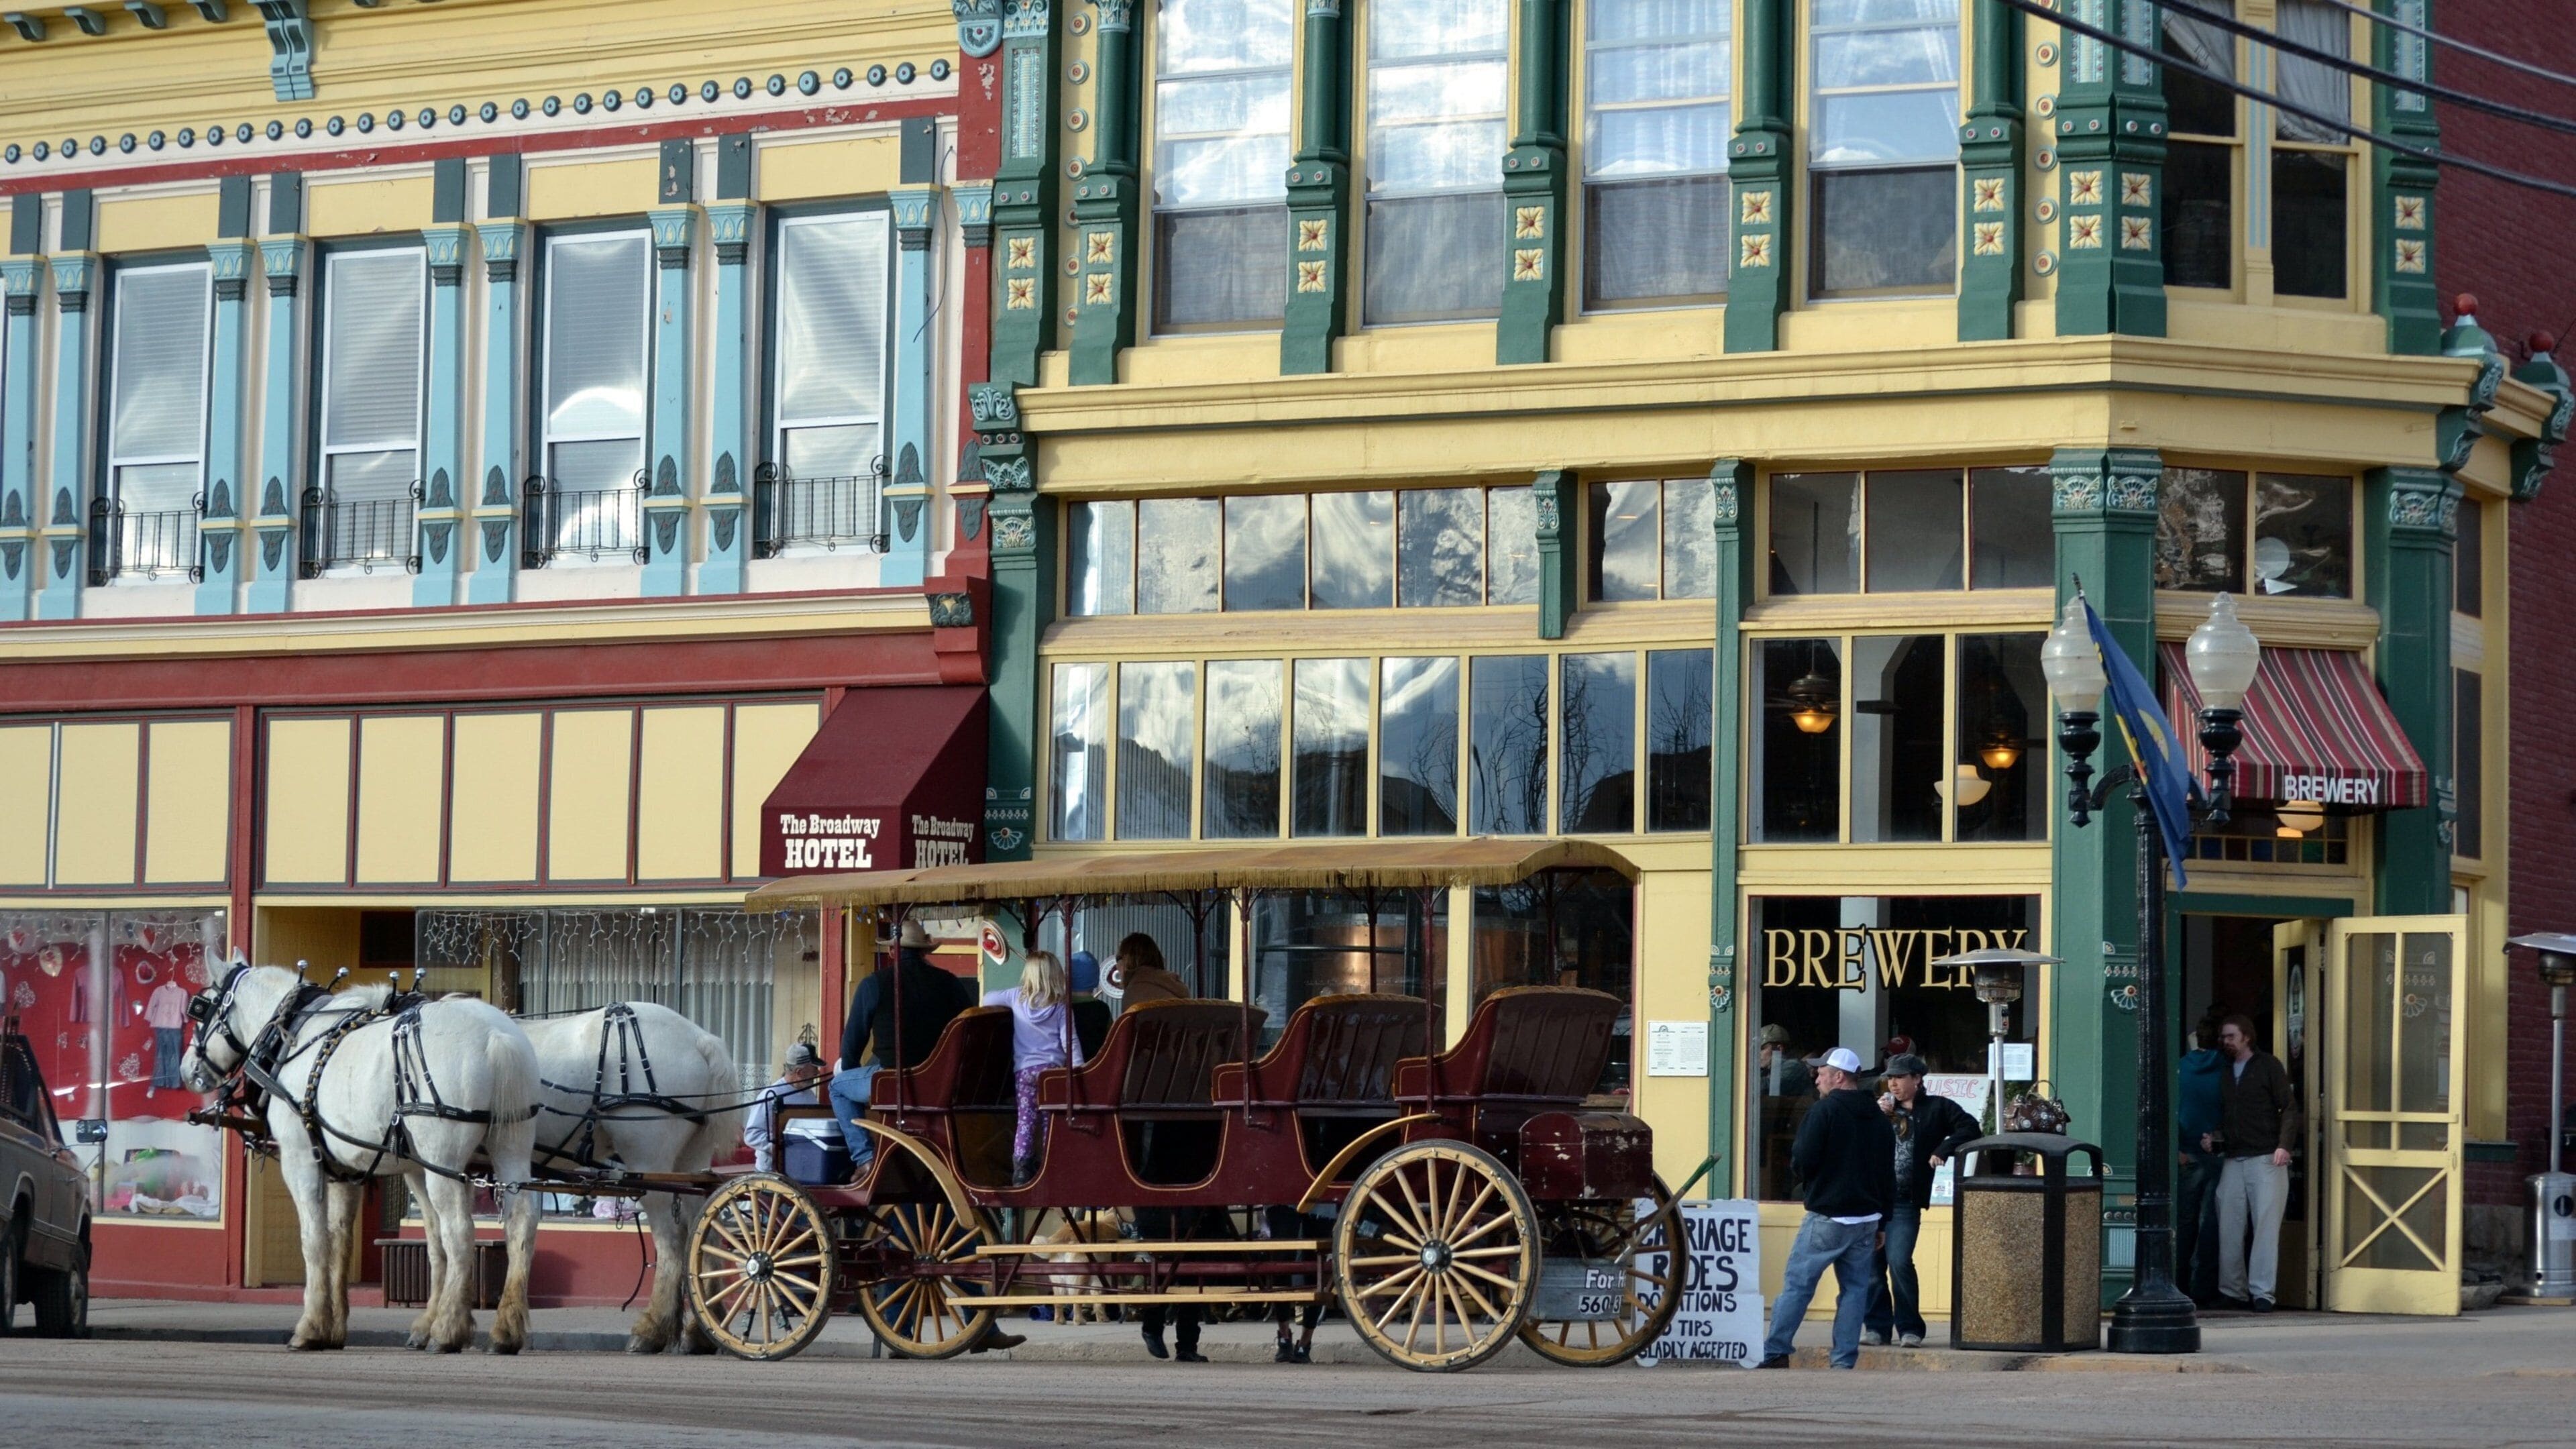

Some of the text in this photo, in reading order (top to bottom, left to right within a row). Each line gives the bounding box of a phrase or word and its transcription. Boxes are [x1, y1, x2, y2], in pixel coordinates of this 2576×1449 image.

[2284, 774, 2381, 804] BREWERY
[780, 814, 881, 839] The Broadway
[912, 815, 975, 843] The Broadway
[785, 839, 872, 869] HOTEL
[914, 839, 969, 869] HOTEL
[1927, 1079, 1979, 1098] USIC
[1585, 1269, 1615, 1289] For
[1652, 1254, 1739, 1292] RDES
[1637, 1292, 1737, 1313] DOTIONS
[1678, 1320, 1713, 1337] TIPS
[1689, 1341, 1748, 1360] ACCEPTED
